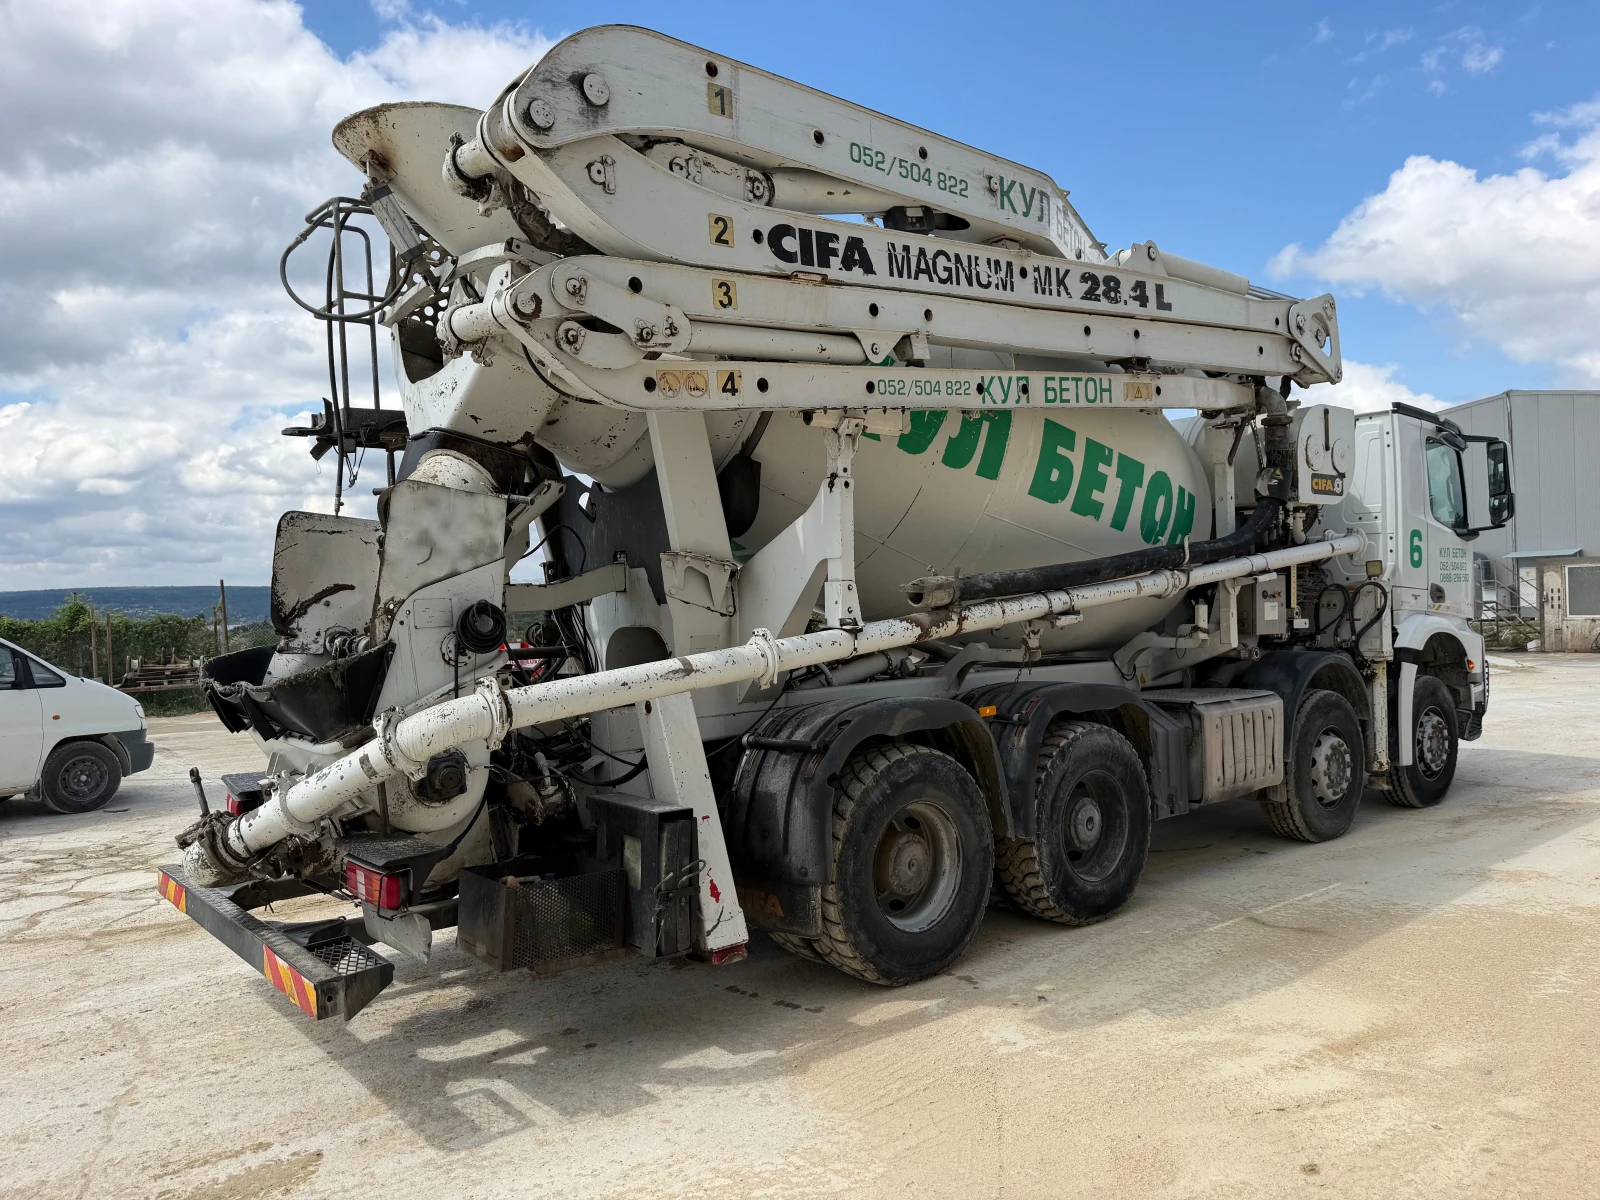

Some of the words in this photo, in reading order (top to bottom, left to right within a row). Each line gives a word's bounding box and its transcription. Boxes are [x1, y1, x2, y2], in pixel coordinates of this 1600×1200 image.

[714, 87, 726, 115] 1
[849, 142, 933, 187] 052/504
[937, 172, 969, 198] 822
[999, 176, 1051, 227] КУЛ
[713, 216, 730, 245] 2
[767, 223, 878, 276] CIFA
[887, 241, 1015, 293] MAGNUM
[1032, 264, 1073, 299] MK
[718, 281, 733, 309] 3
[722, 372, 739, 397] 4
[877, 379, 942, 397] 052/504
[945, 380, 972, 396] 822
[980, 375, 1030, 404] КУЛ
[1044, 376, 1113, 404] БЕТОН
[1028, 418, 1196, 546] БЕТОН
[1312, 478, 1334, 491] CIFA
[1409, 529, 1423, 568] 6
